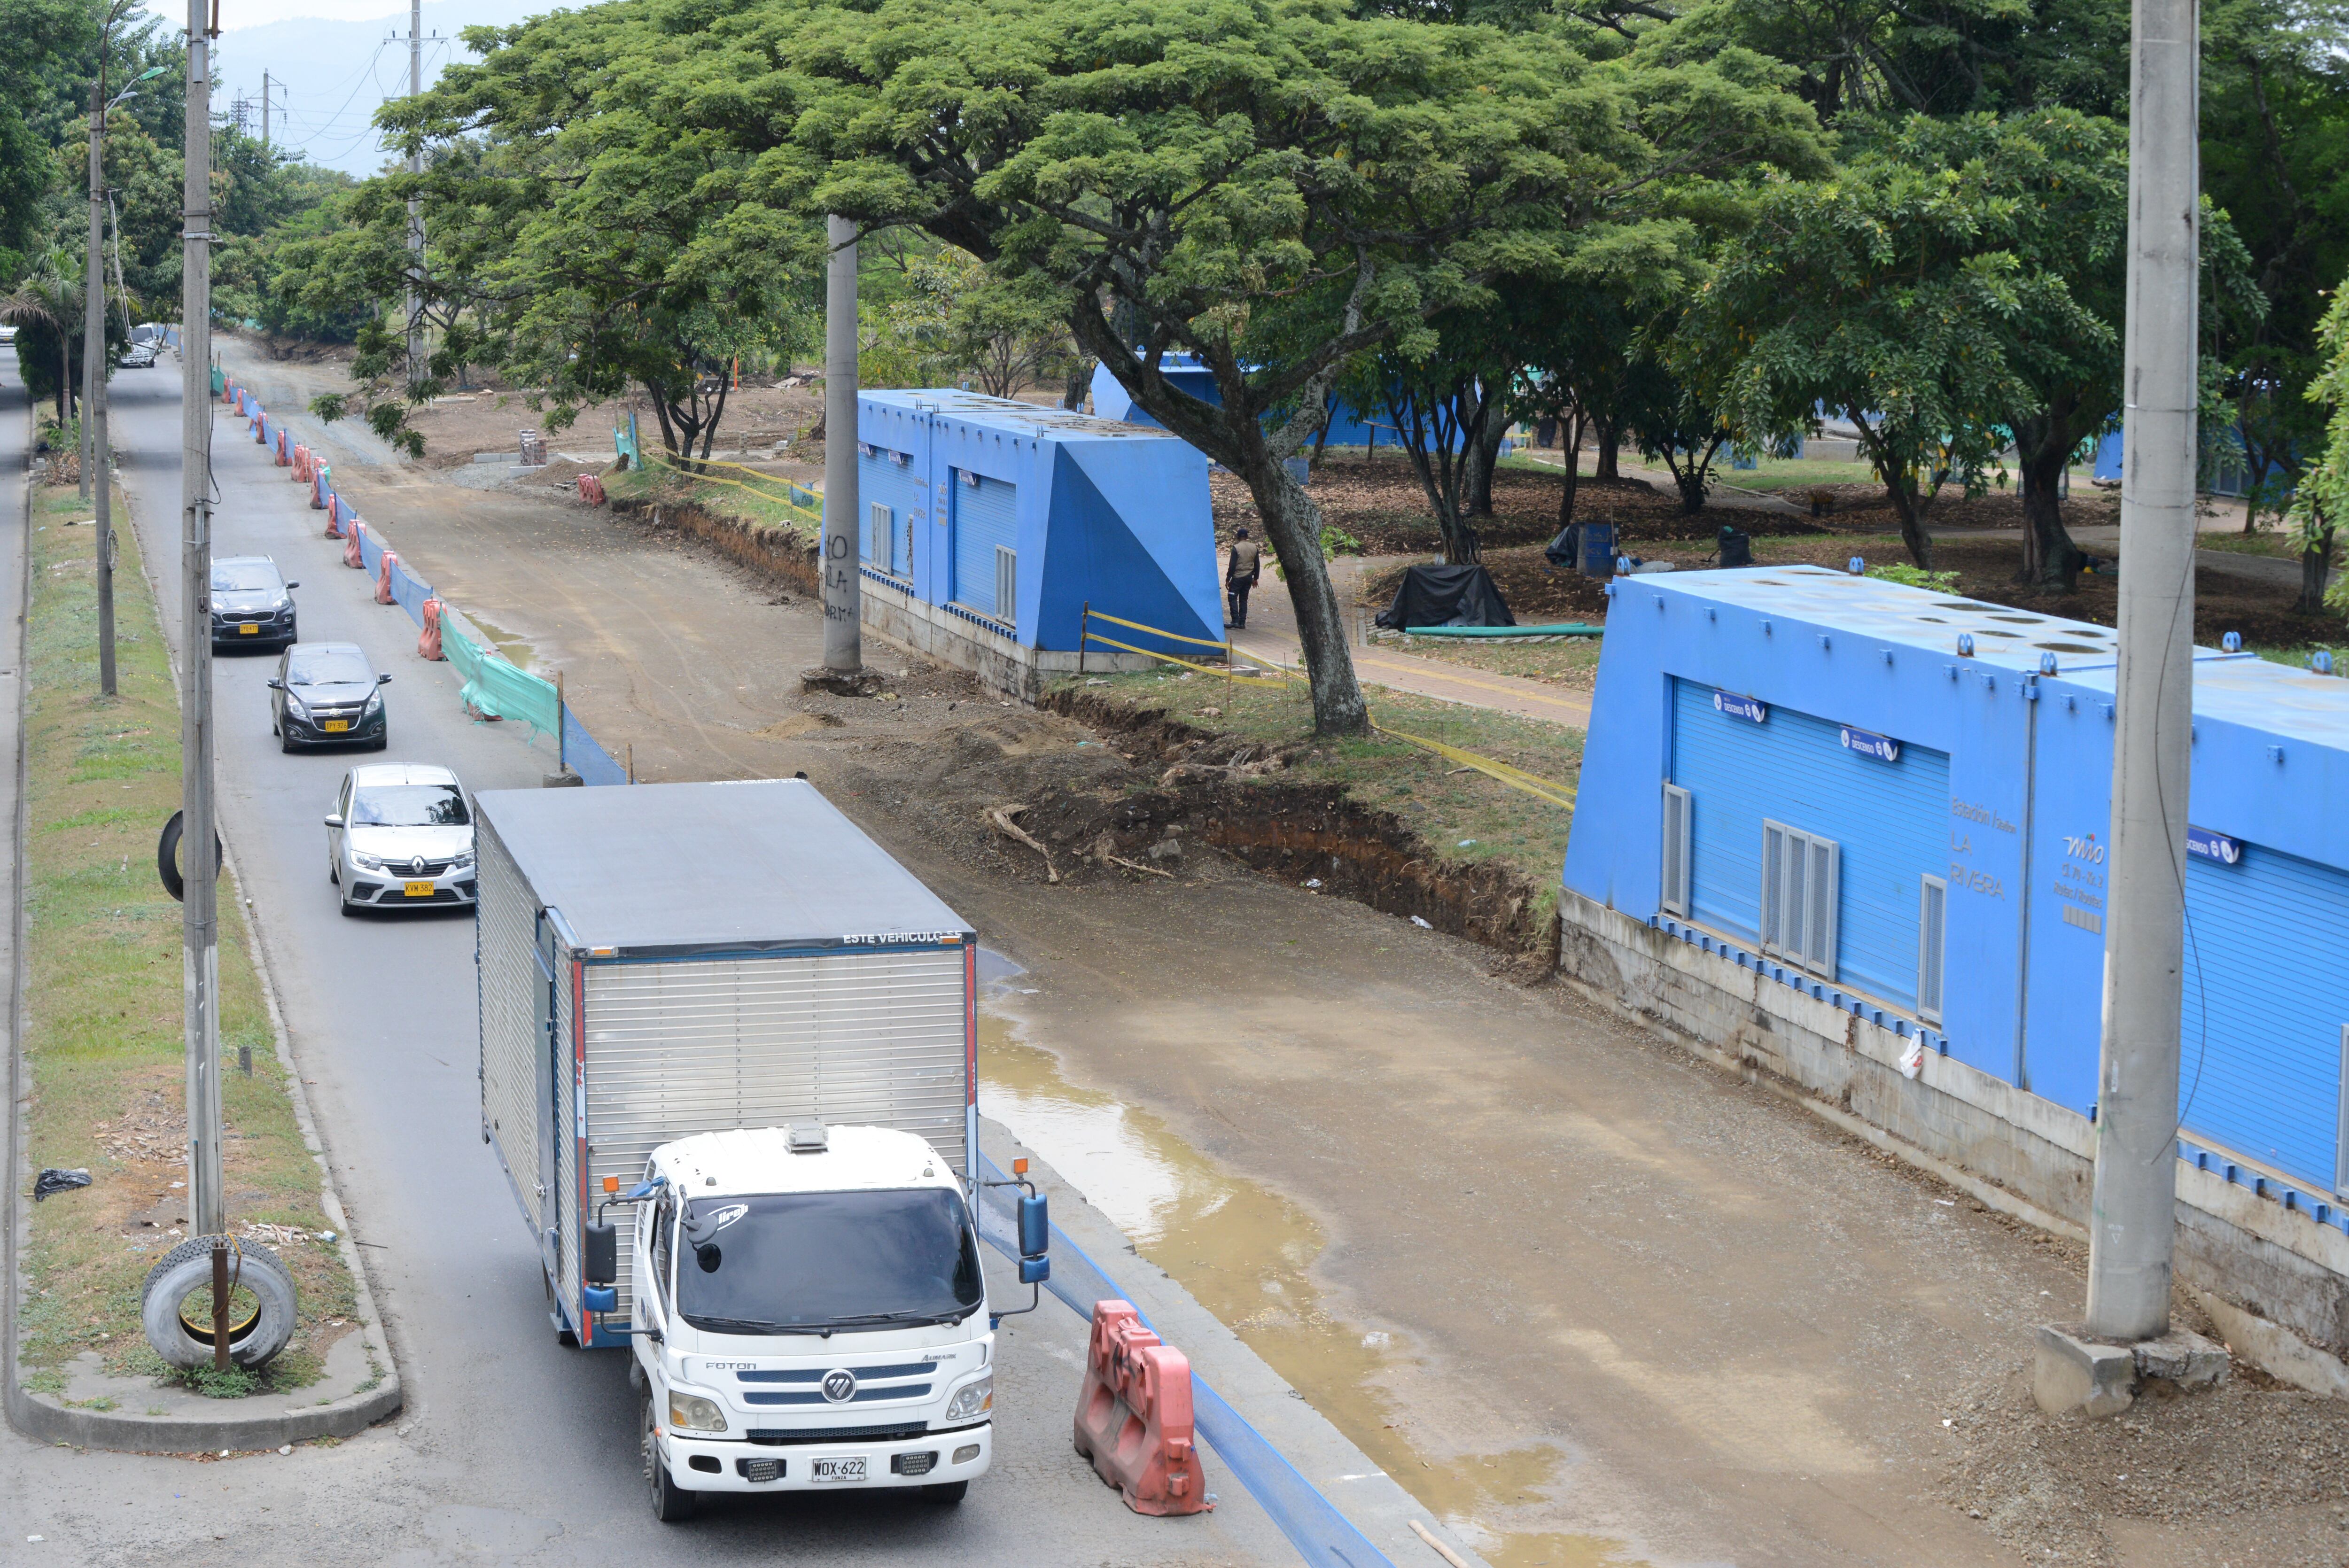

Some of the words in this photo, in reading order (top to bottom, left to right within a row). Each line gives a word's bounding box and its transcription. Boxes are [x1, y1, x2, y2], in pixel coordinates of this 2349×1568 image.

[1724, 703, 1744, 715] DESCENSO
[1852, 739, 1874, 753] DESCENSO
[1952, 797, 1990, 826] Estación
[1952, 830, 1972, 856] LA
[2186, 839, 2209, 854] SCENSO
[1951, 862, 2005, 901] RIVERA
[843, 934, 875, 944] ESTE
